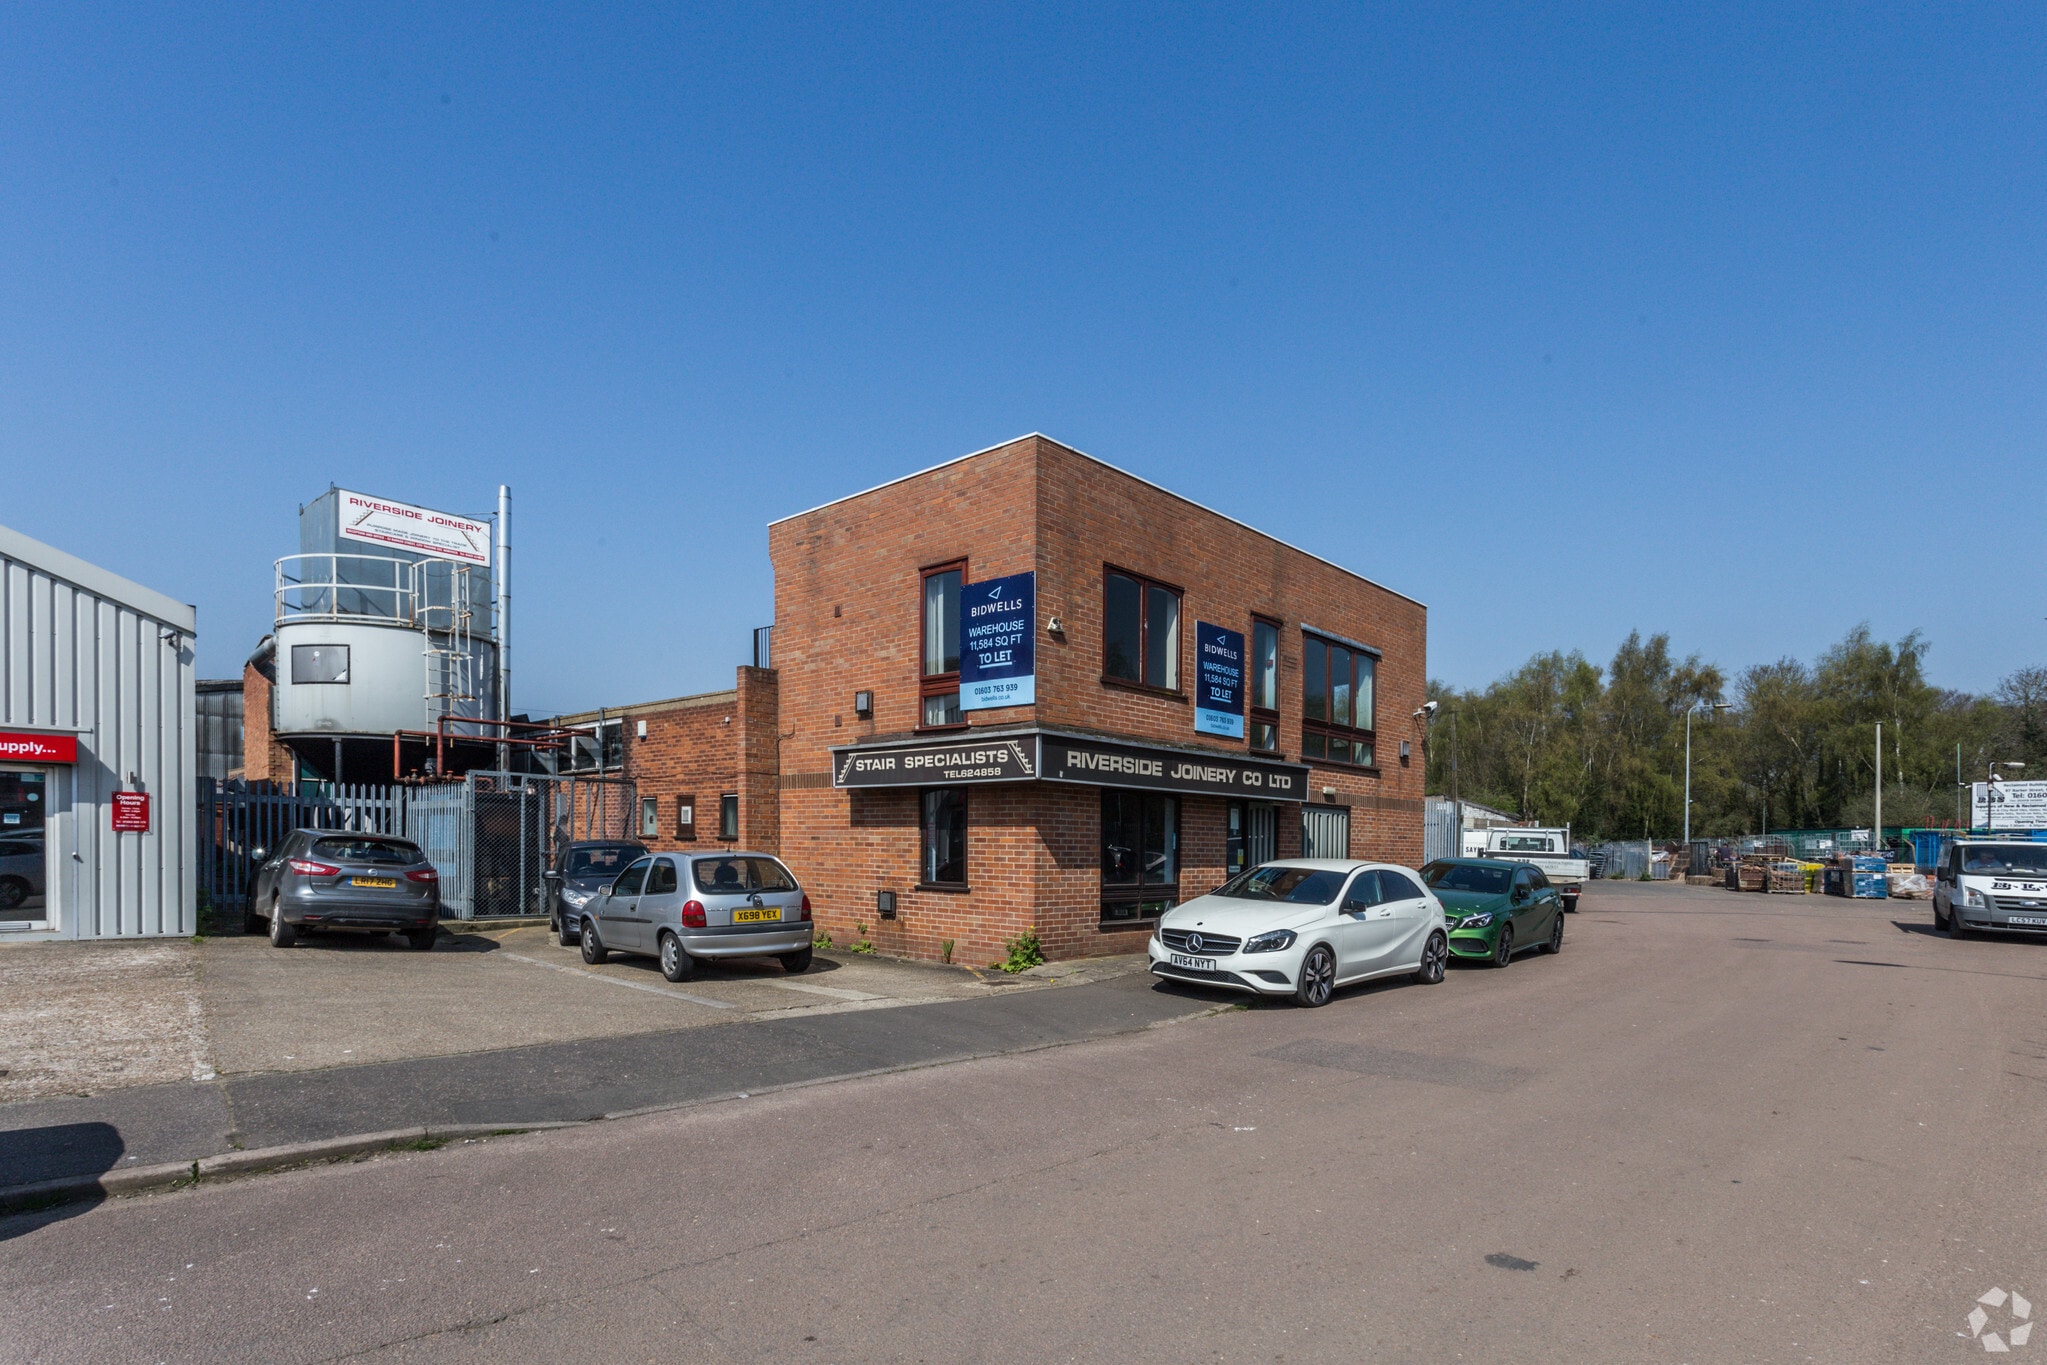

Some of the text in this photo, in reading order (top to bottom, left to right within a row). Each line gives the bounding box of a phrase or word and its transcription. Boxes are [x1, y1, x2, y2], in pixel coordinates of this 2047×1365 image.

[350, 498, 482, 533] RIVERSIDE JOINERY
[971, 598, 1022, 617] BIDWELLS
[969, 620, 1024, 638] WAREHOUSE
[970, 634, 1022, 652] 11,584 SQ FT
[979, 650, 1012, 664] TO LET
[1204, 644, 1238, 660] BIDWELLS
[1203, 662, 1239, 678] WAREHOUSE
[1204, 673, 1238, 688] 11,584 SQ FT
[974, 683, 1018, 696] 01603 763 939
[1210, 686, 1232, 699] TO LET
[856, 749, 1008, 771] STAIR SPECIALISTS
[1067, 750, 1291, 789] RIVERSIDE JOINERY CO LTD
[738, 910, 777, 920] X698 YEX
[1174, 956, 1211, 969] AV64 NYT
